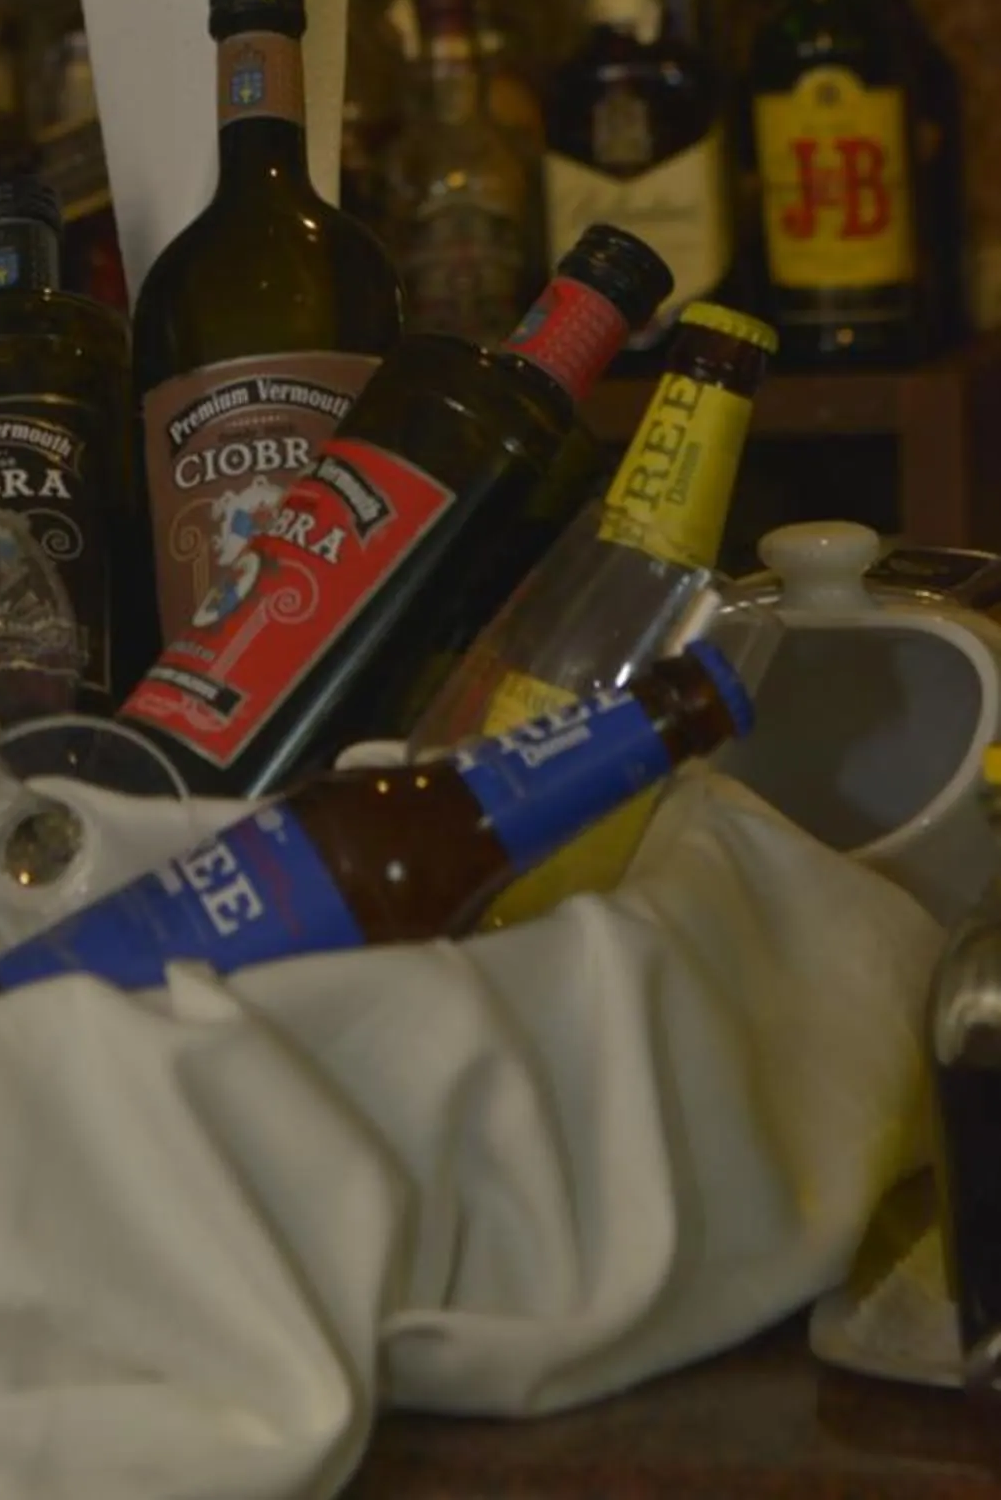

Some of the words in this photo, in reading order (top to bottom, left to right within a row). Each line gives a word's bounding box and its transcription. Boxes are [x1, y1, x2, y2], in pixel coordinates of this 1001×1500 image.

[169, 385, 249, 446] Premium
[174, 436, 311, 490] CIOBR
[275, 505, 347, 565] BRA
